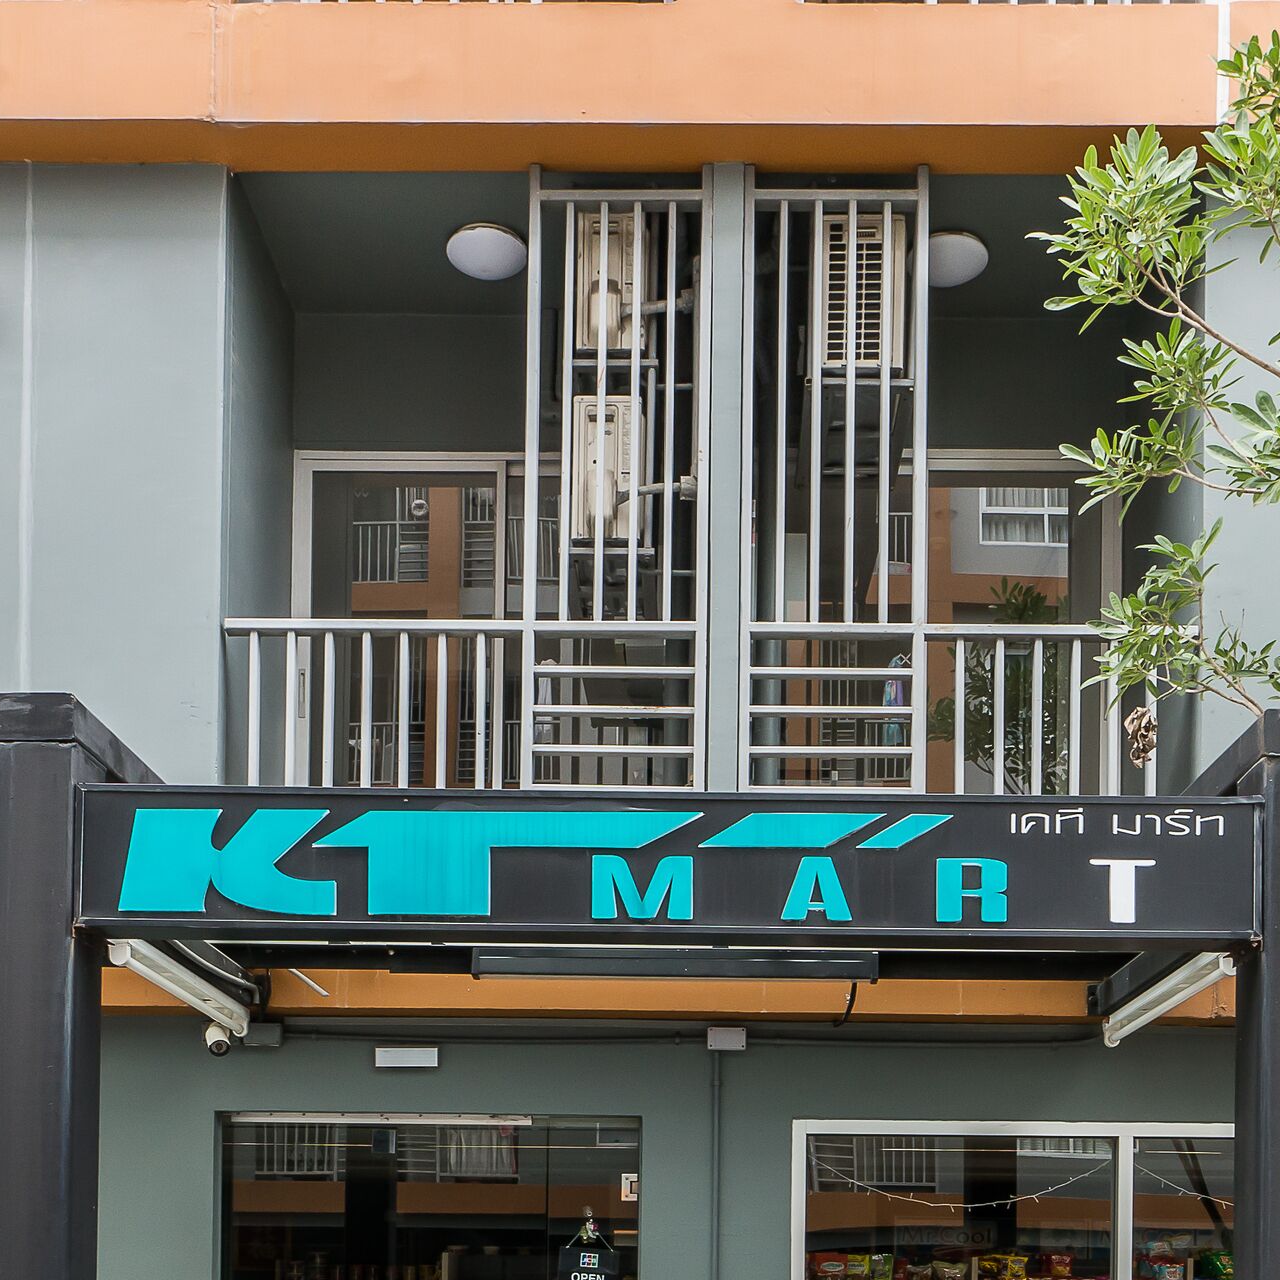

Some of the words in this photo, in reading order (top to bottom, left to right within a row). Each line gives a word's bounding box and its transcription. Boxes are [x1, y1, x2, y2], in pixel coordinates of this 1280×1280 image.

[1010, 807, 1084, 835] เคที
[1111, 808, 1225, 837] มาร์ท
[591, 854, 1158, 925] MART
